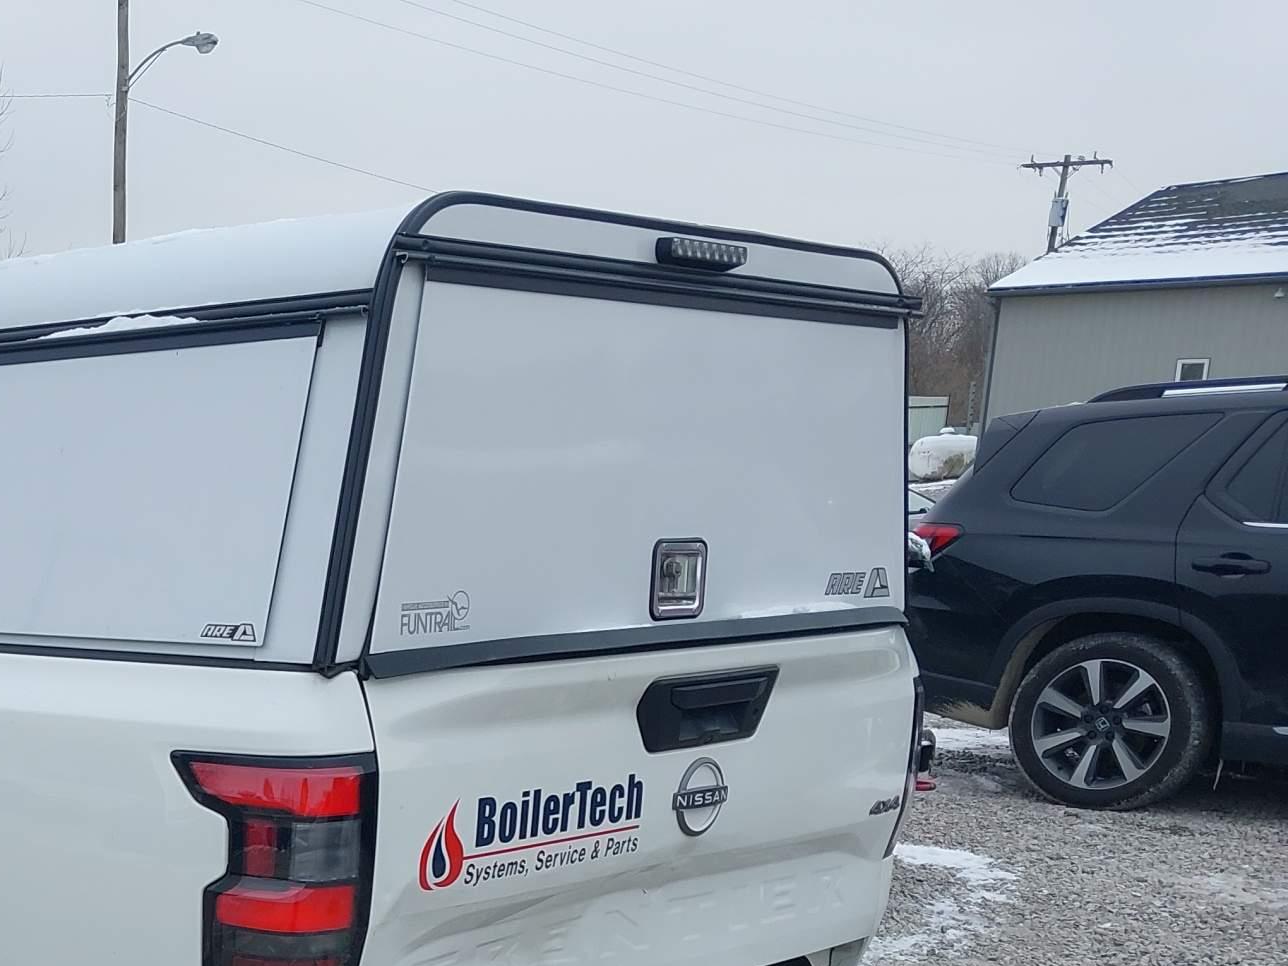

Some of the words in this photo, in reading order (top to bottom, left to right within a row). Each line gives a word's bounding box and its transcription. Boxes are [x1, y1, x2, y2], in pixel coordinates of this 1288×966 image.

[475, 773, 644, 848] BoilerTech
[676, 787, 728, 808] NISSAN
[464, 858, 529, 887] Systems,
[535, 845, 587, 871] Service
[591, 840, 601, 860] &
[604, 836, 639, 857] Parts
